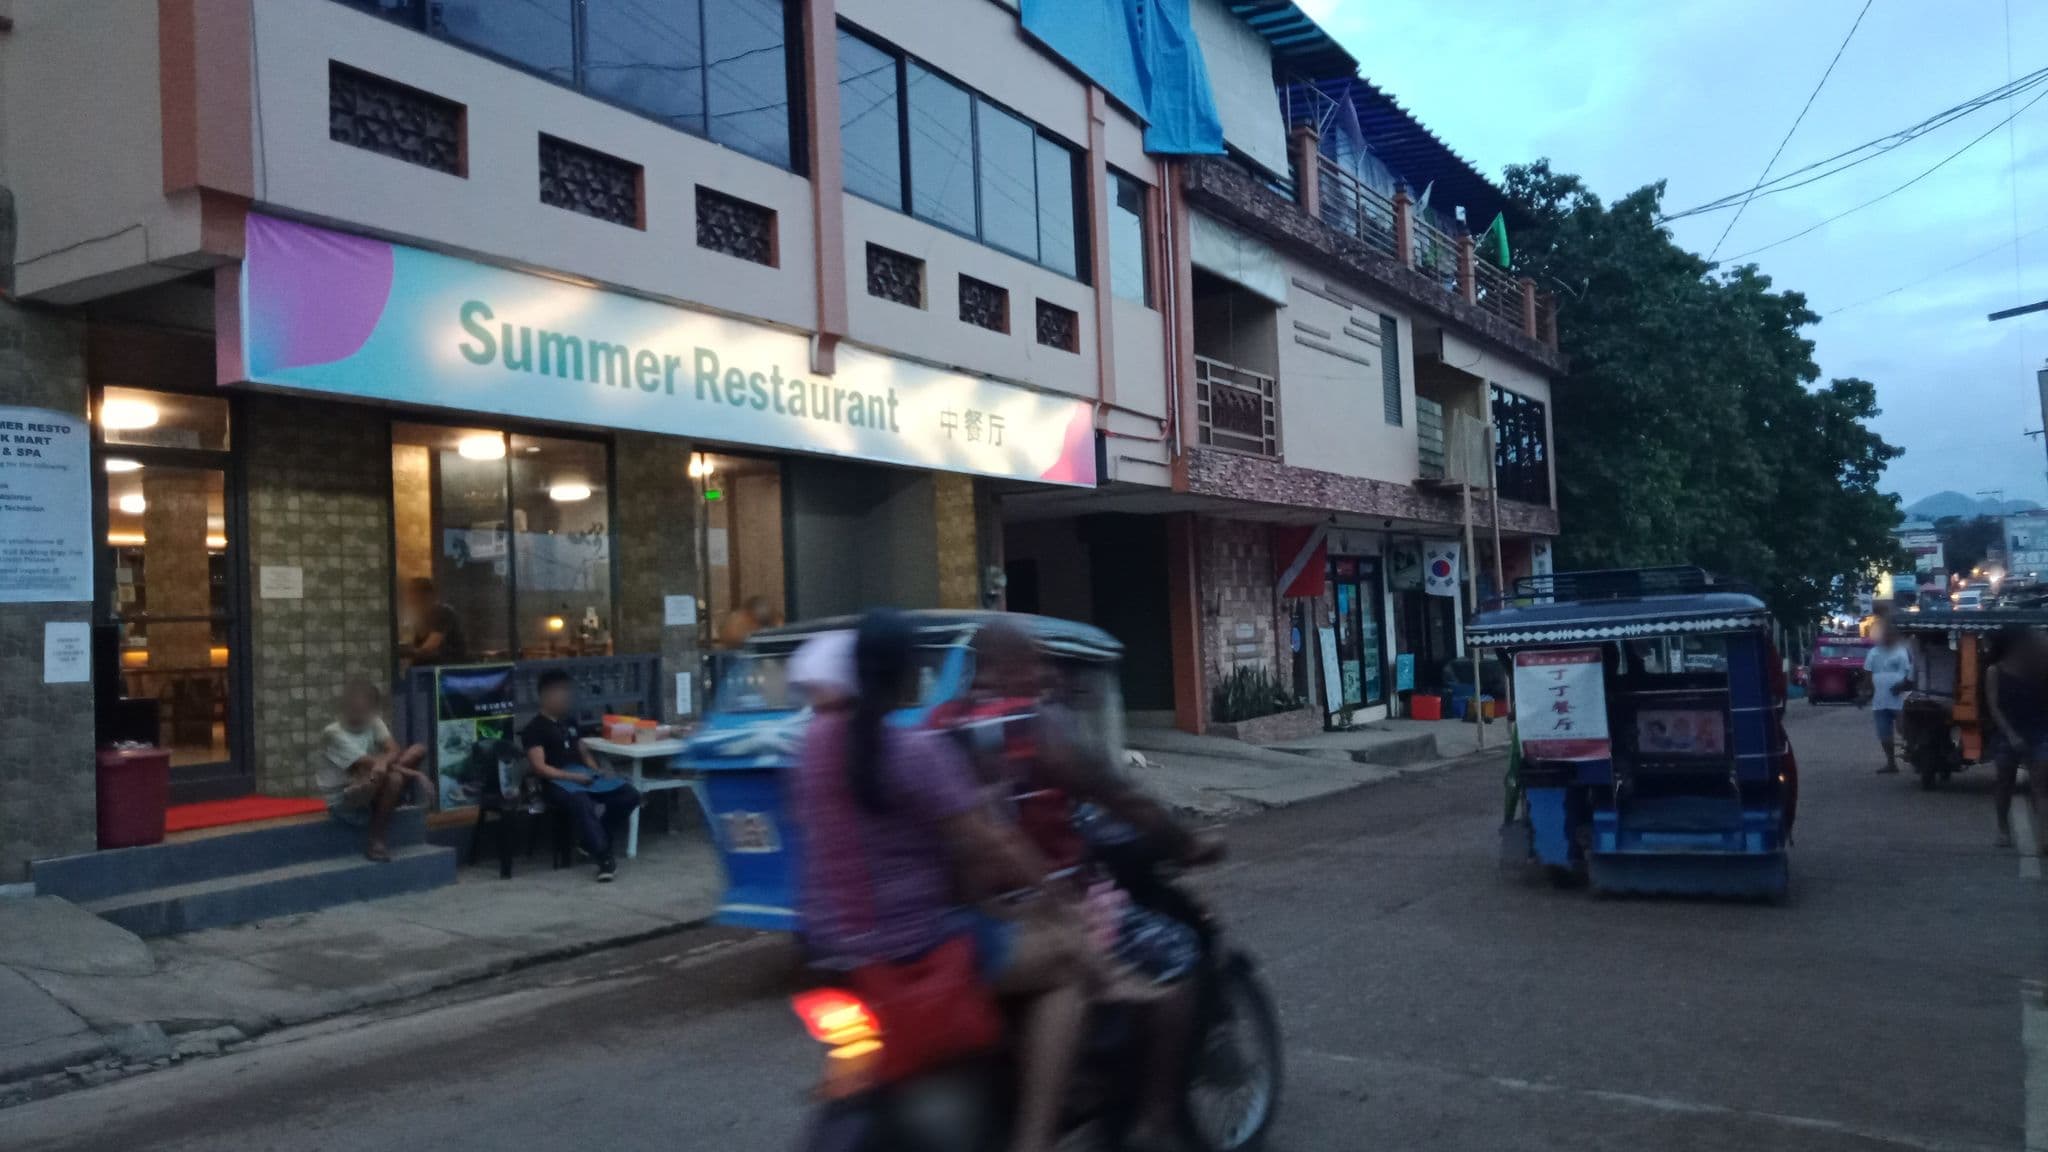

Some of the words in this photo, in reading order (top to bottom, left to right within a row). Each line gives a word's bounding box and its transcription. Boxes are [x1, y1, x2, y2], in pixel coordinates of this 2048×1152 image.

[459, 299, 681, 396] Summer
[694, 345, 900, 433] Restaurant
[28, 423, 71, 434] RESTO
[940, 408, 1005, 446] 中餐厅
[2, 447, 12, 456] &
[17, 448, 42, 457] SPA
[14, 435, 52, 445] MART
[1547, 668, 1577, 731] 丁丁餐厅
